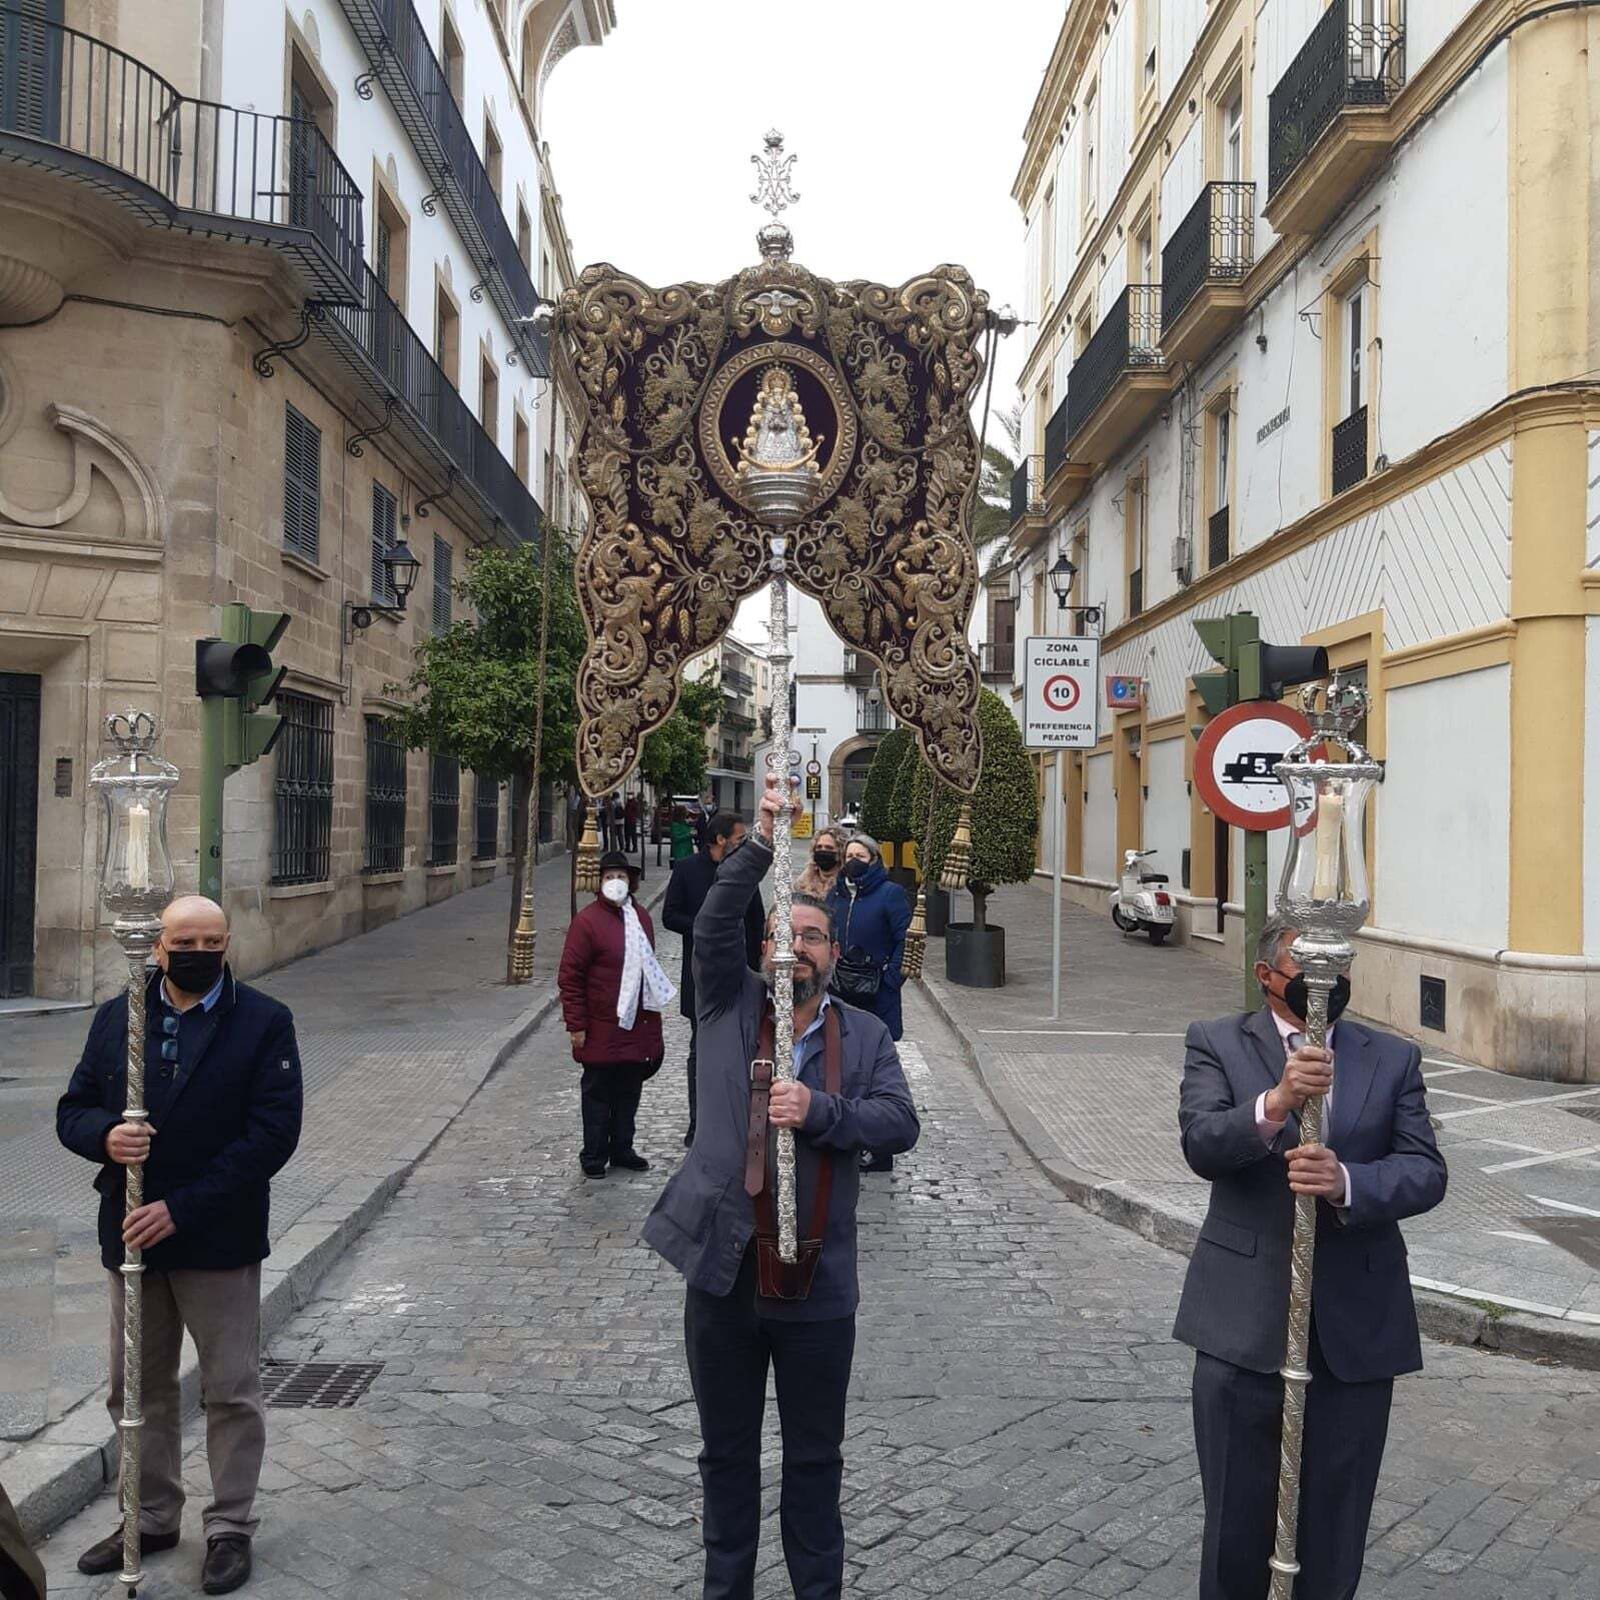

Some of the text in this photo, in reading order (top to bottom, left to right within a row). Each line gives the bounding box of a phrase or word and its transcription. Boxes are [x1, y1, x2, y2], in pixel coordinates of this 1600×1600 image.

[1046, 644, 1078, 652] ZONA
[1034, 658, 1090, 667] CICLABLE
[1053, 687, 1070, 698] 10
[1029, 723, 1092, 731] PREFERENCIA
